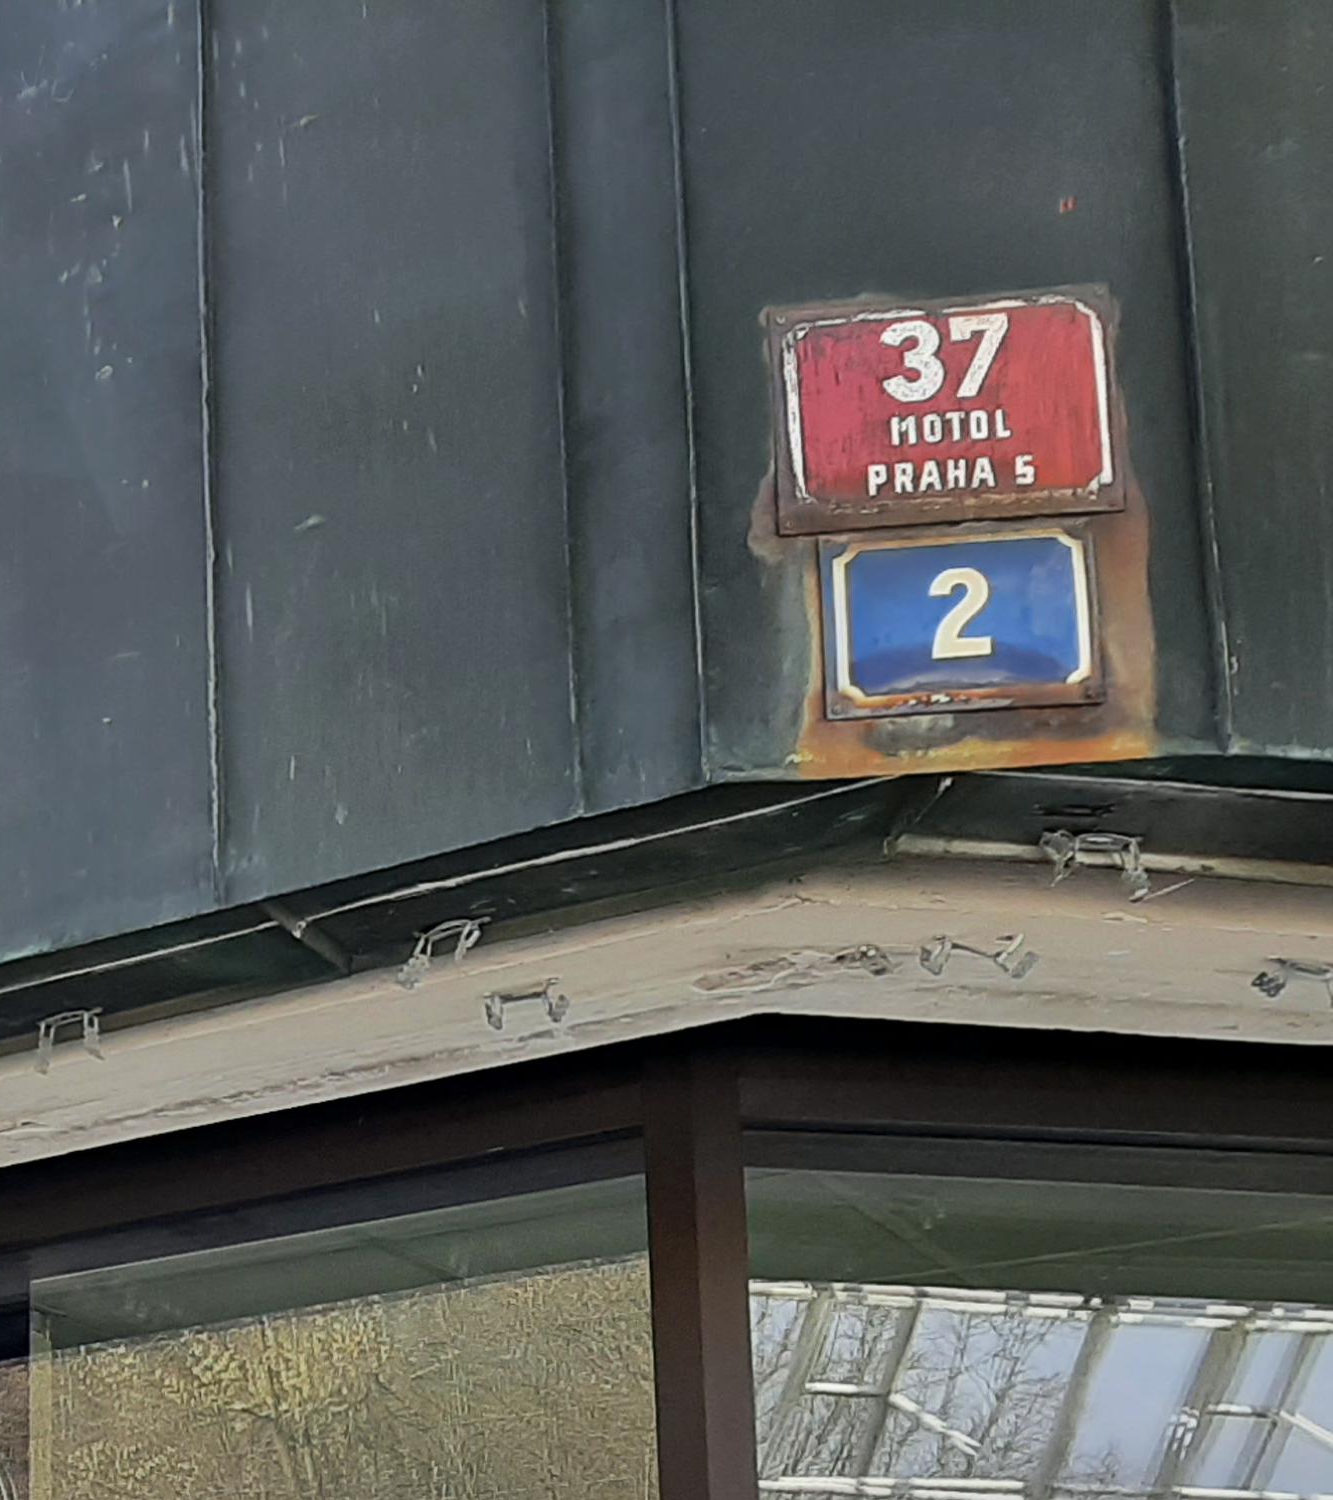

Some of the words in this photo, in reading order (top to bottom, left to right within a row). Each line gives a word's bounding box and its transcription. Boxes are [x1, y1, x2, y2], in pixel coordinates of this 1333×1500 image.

[880, 311, 1009, 402] 37
[889, 409, 1012, 446] MOTOL
[867, 456, 996, 497] PRAHA
[1014, 454, 1035, 485] 5
[928, 567, 992, 660] 2
